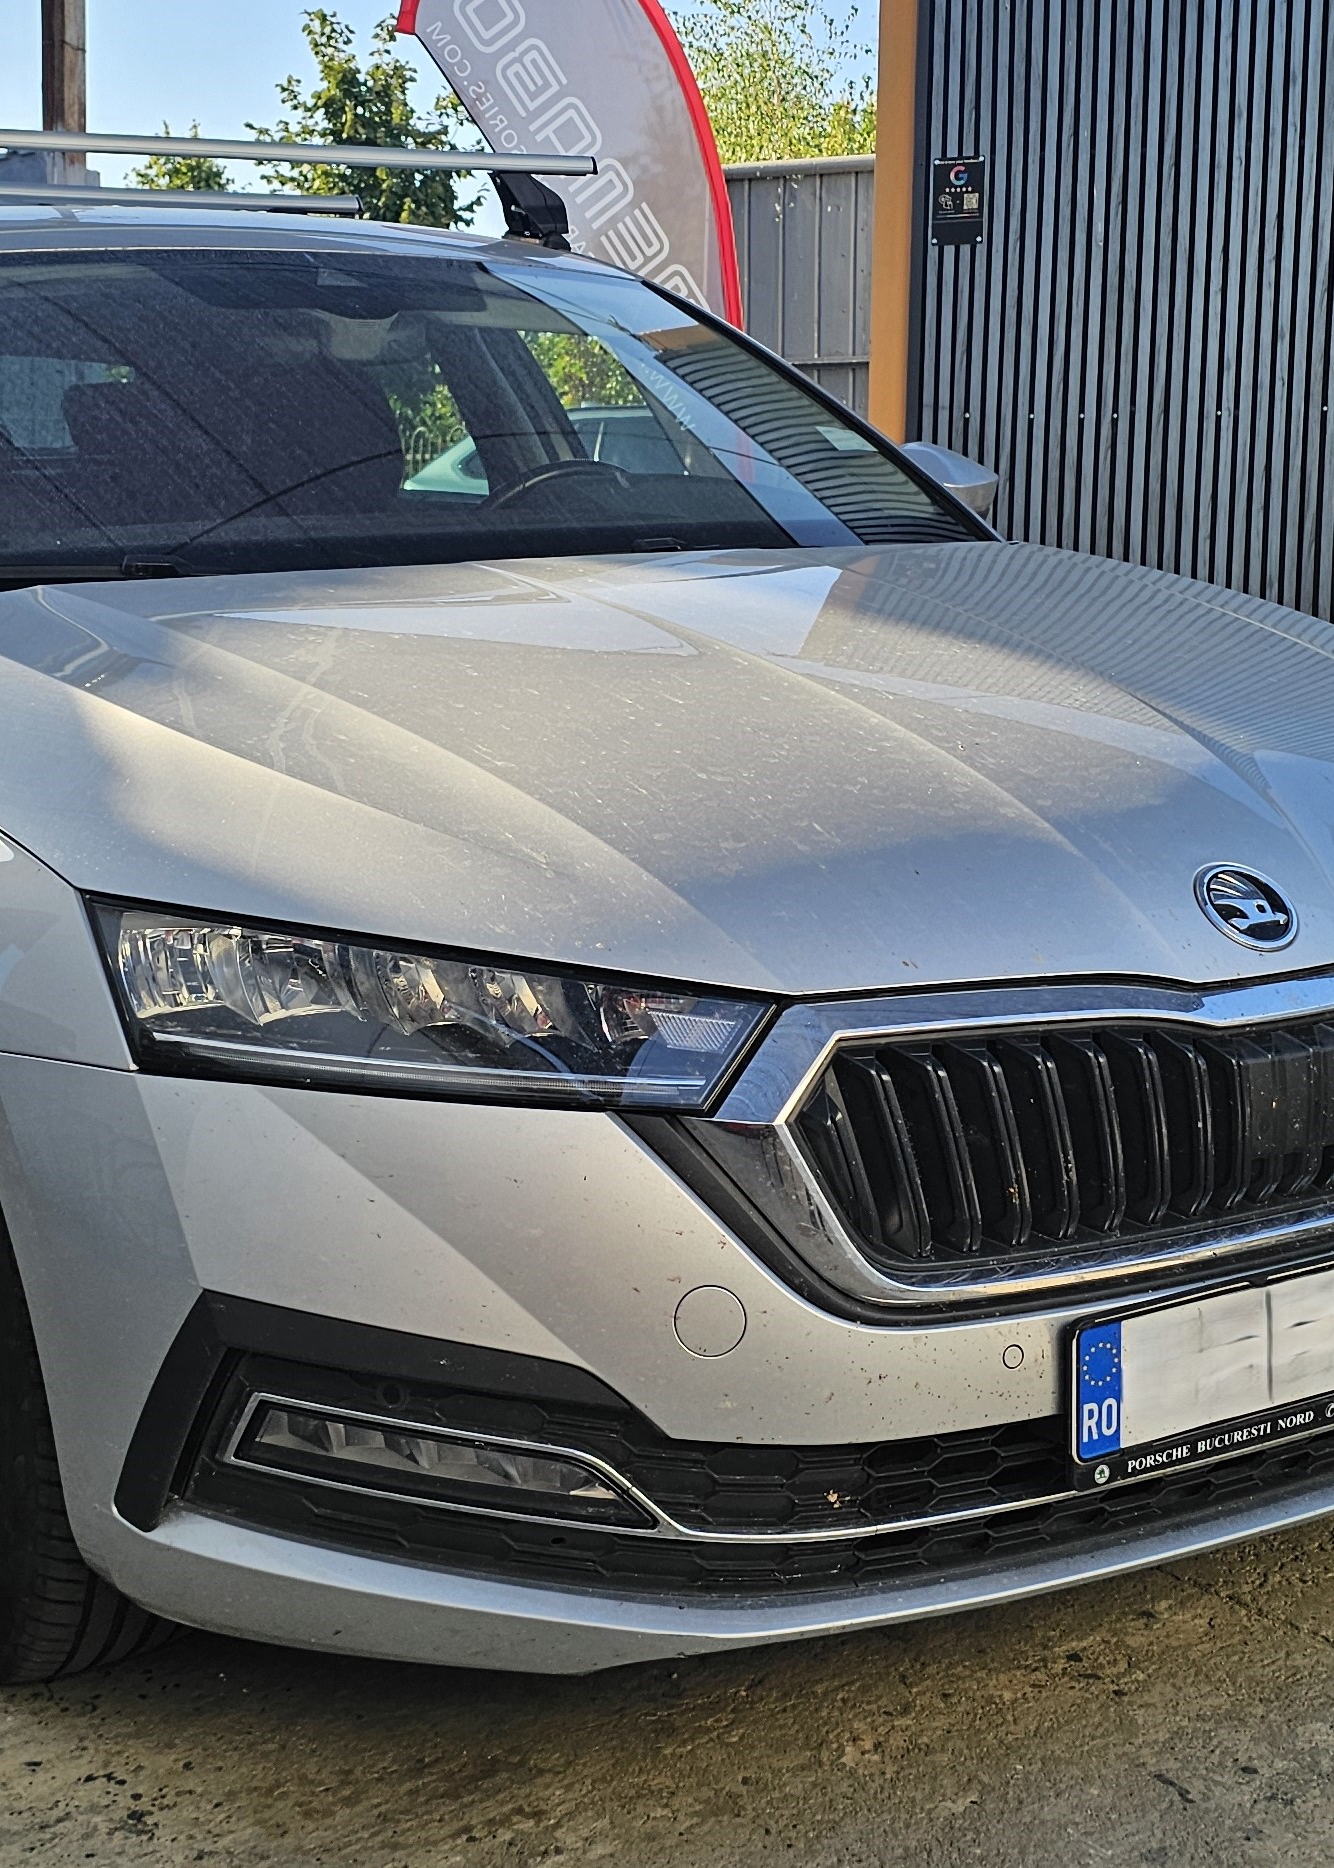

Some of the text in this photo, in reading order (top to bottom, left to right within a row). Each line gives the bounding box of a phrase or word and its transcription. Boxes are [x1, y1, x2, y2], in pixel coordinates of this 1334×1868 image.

[950, 165, 968, 186] G
[1082, 1397, 1118, 1443] RO
[1127, 1444, 1191, 1473] PORSCHE
[1197, 1421, 1272, 1454] BUCURESTI
[1277, 1410, 1315, 1431] NORD
